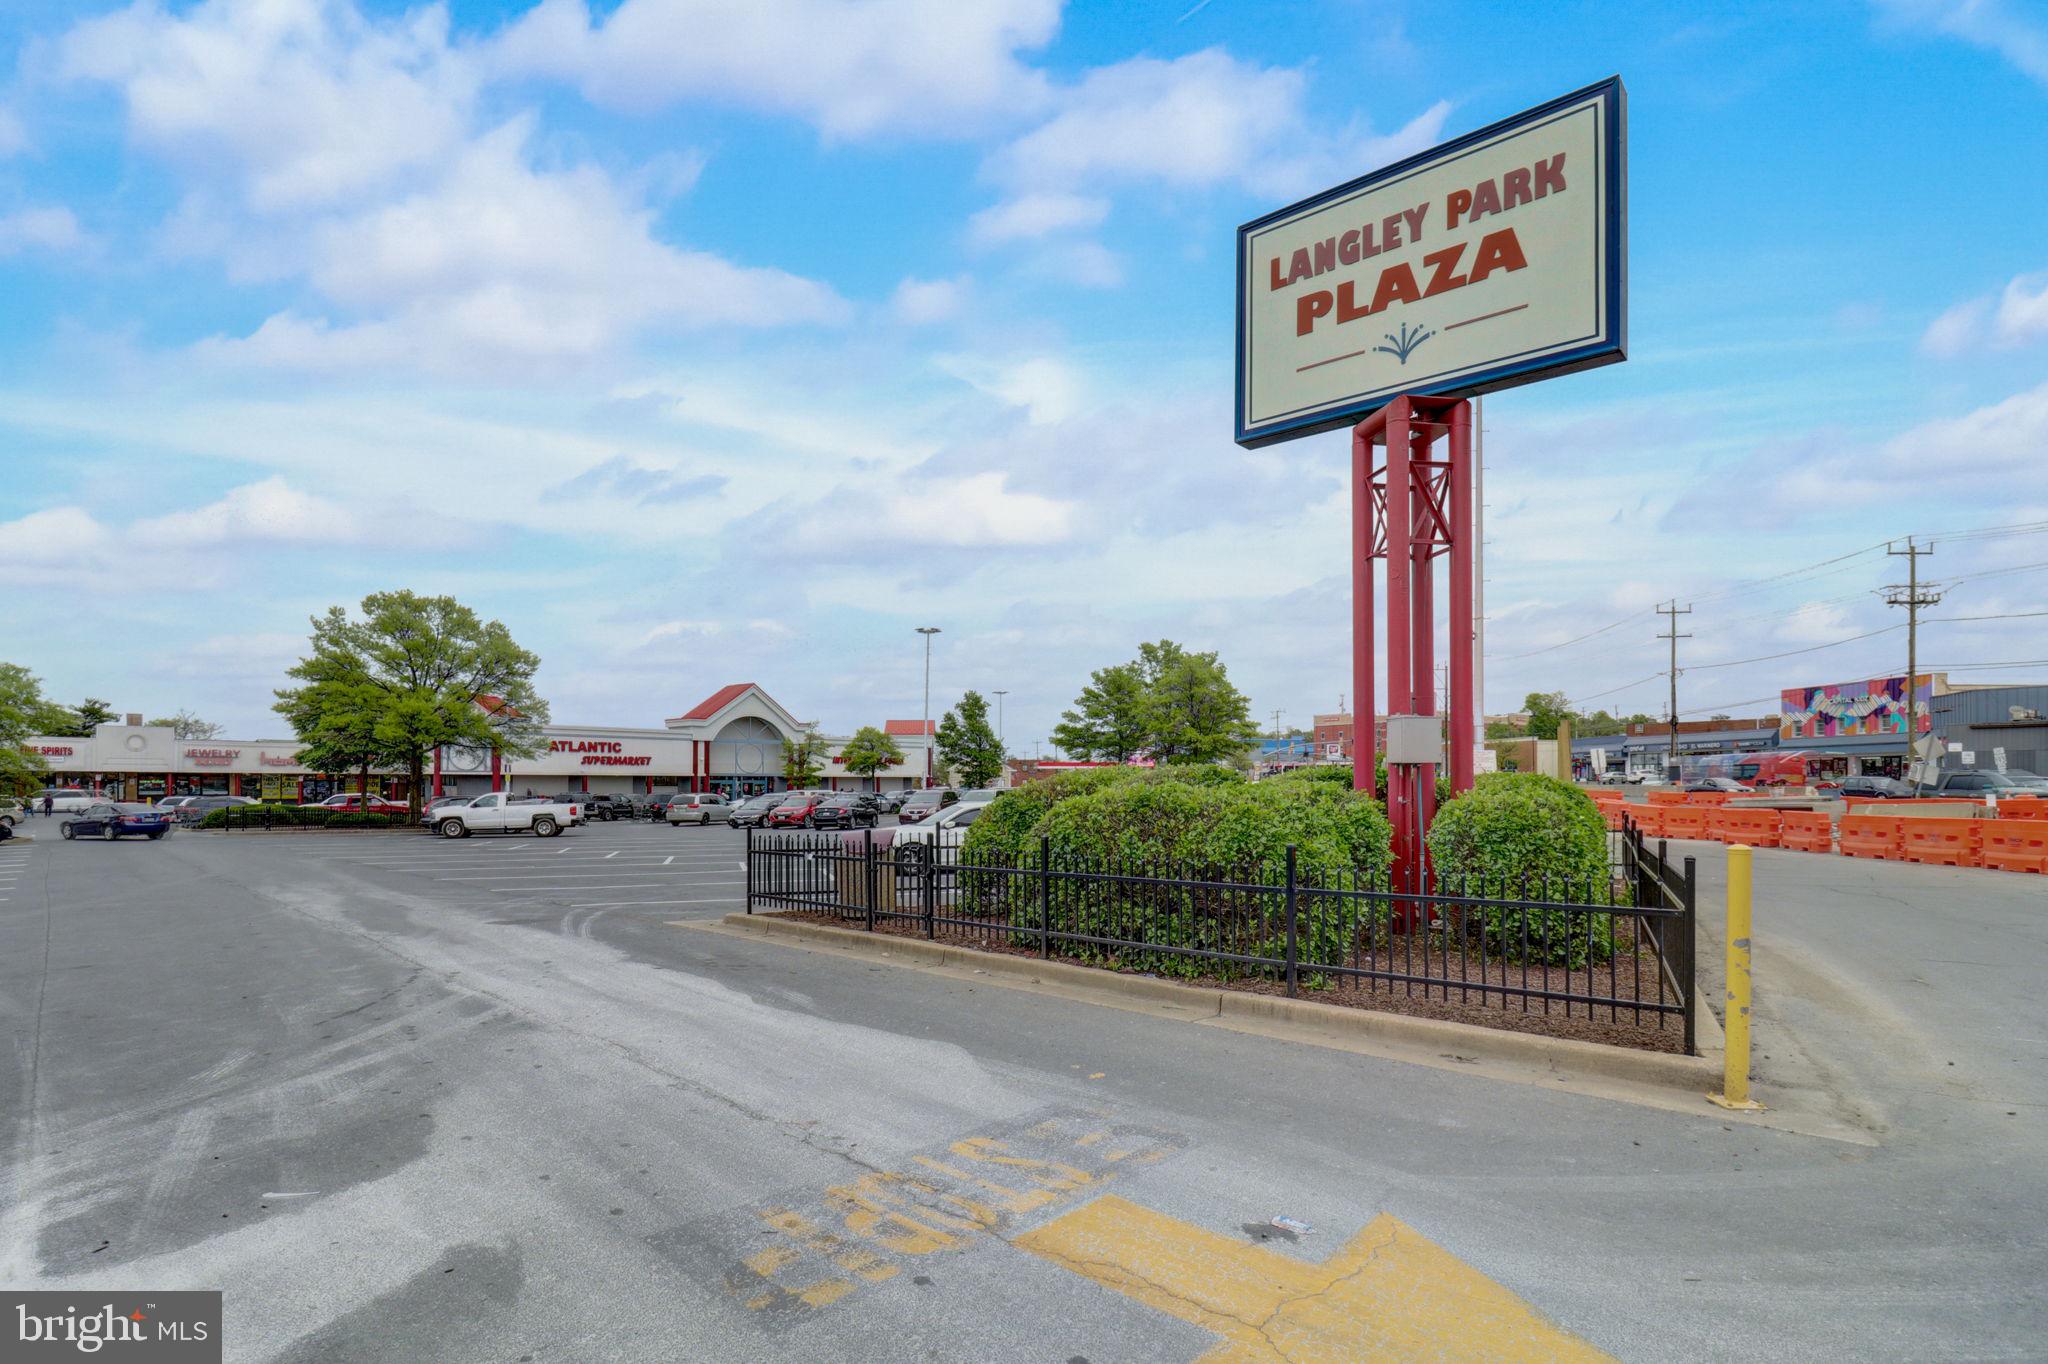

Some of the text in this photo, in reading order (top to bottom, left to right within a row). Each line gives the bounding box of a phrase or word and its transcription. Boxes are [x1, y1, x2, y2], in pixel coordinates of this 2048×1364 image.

[1270, 152, 1567, 292] LANGLEY PARK
[1296, 227, 1528, 338] PLAZA
[41, 746, 73, 756] SPIRITS
[549, 740, 622, 754] ATLANTIC
[184, 749, 241, 758] JEWELRY
[581, 755, 652, 766] SUPERMARKET
